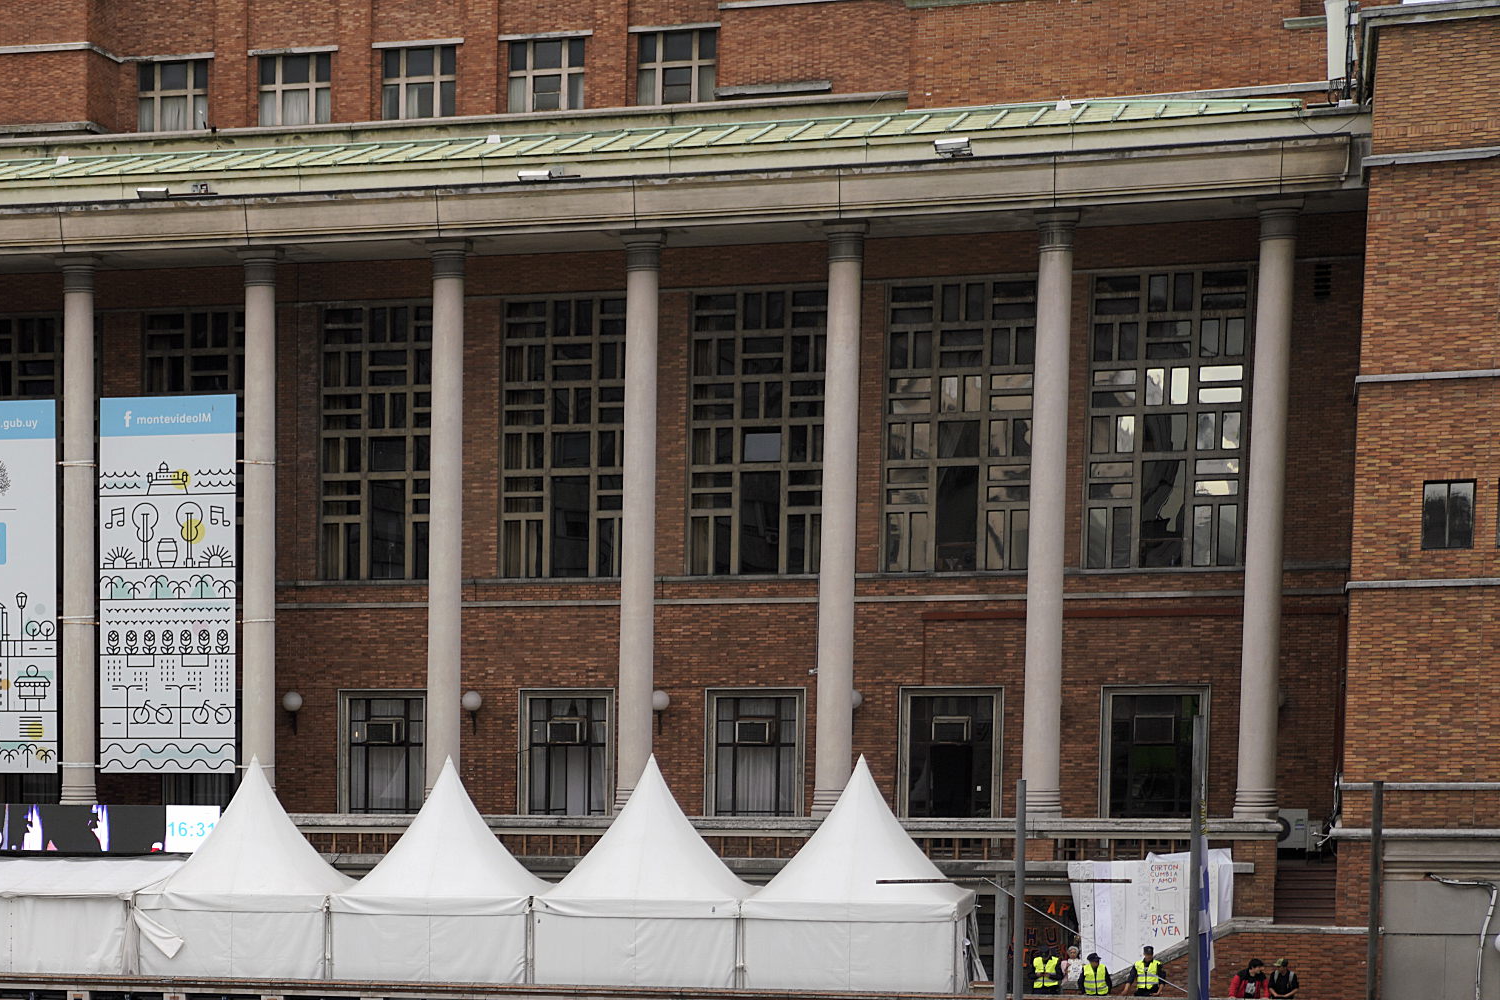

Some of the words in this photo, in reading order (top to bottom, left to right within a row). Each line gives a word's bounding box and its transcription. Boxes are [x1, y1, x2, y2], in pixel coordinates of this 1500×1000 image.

[136, 413, 212, 424] montevideoIM
[1151, 914, 1175, 925] PASE
[1152, 928, 1158, 936] Y
[1161, 926, 1180, 936] VEA
